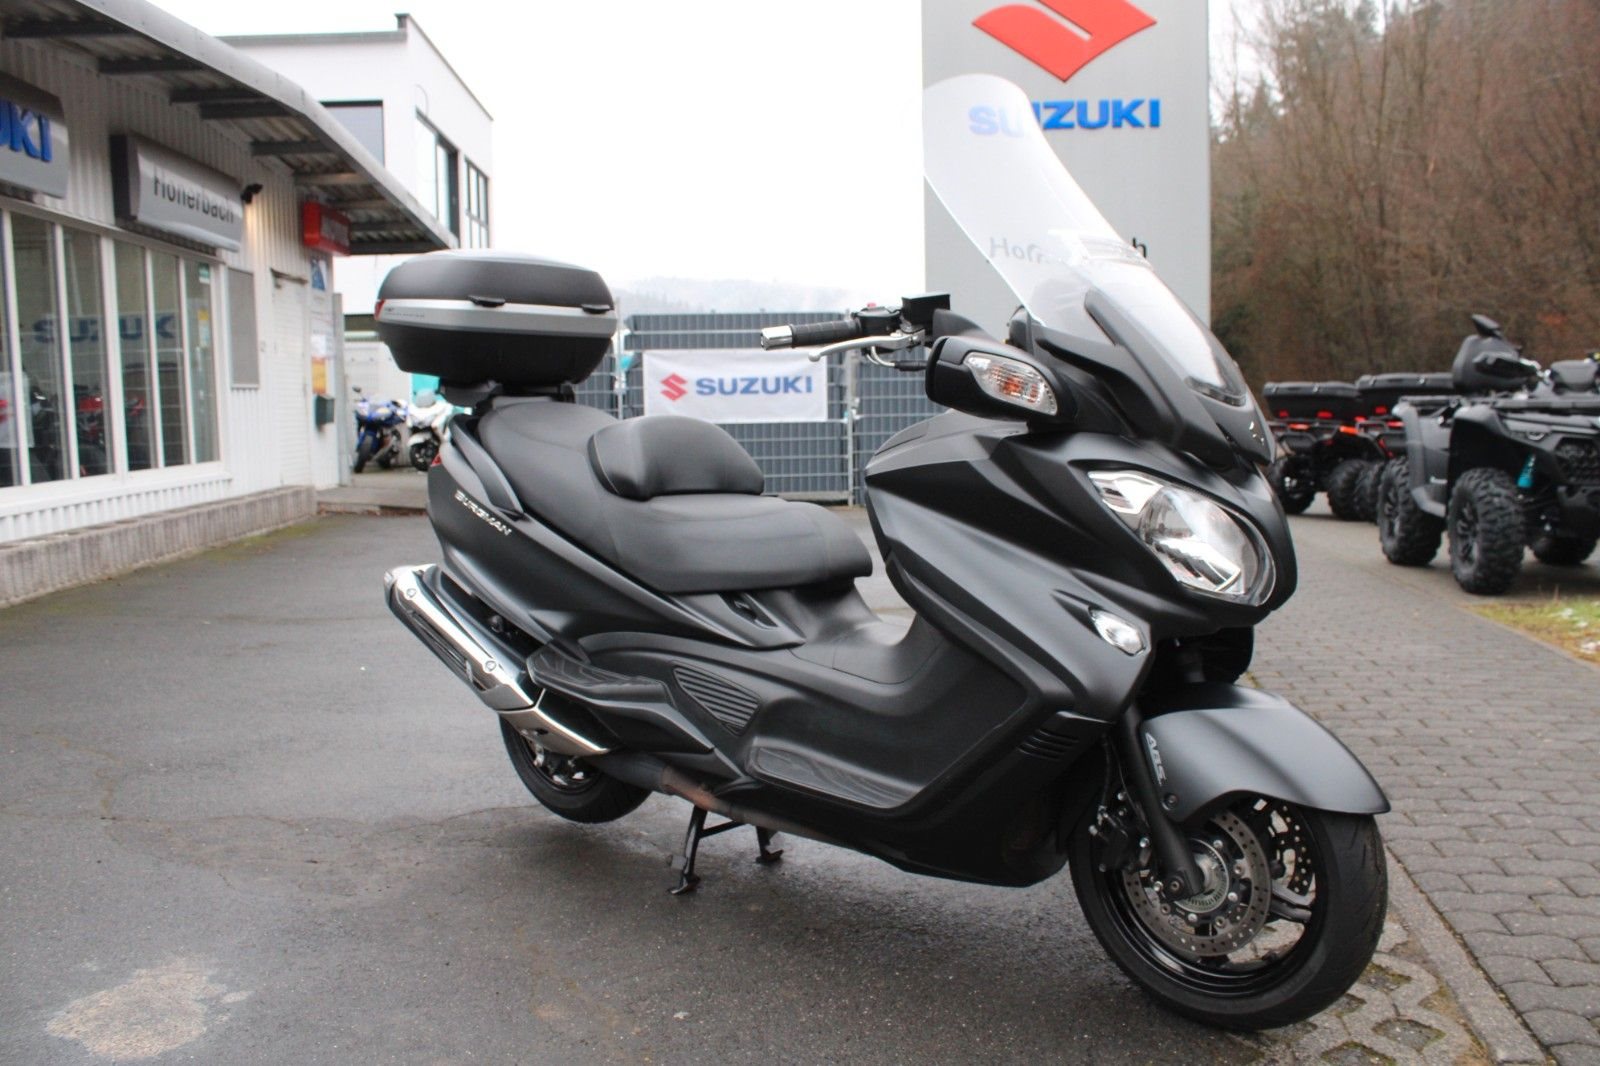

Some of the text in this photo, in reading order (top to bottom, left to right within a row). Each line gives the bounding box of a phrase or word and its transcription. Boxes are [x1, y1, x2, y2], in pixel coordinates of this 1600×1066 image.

[968, 98, 1161, 137] SUZUKI
[695, 374, 813, 397] SUZUKI
[1145, 732, 1167, 787] ABS
